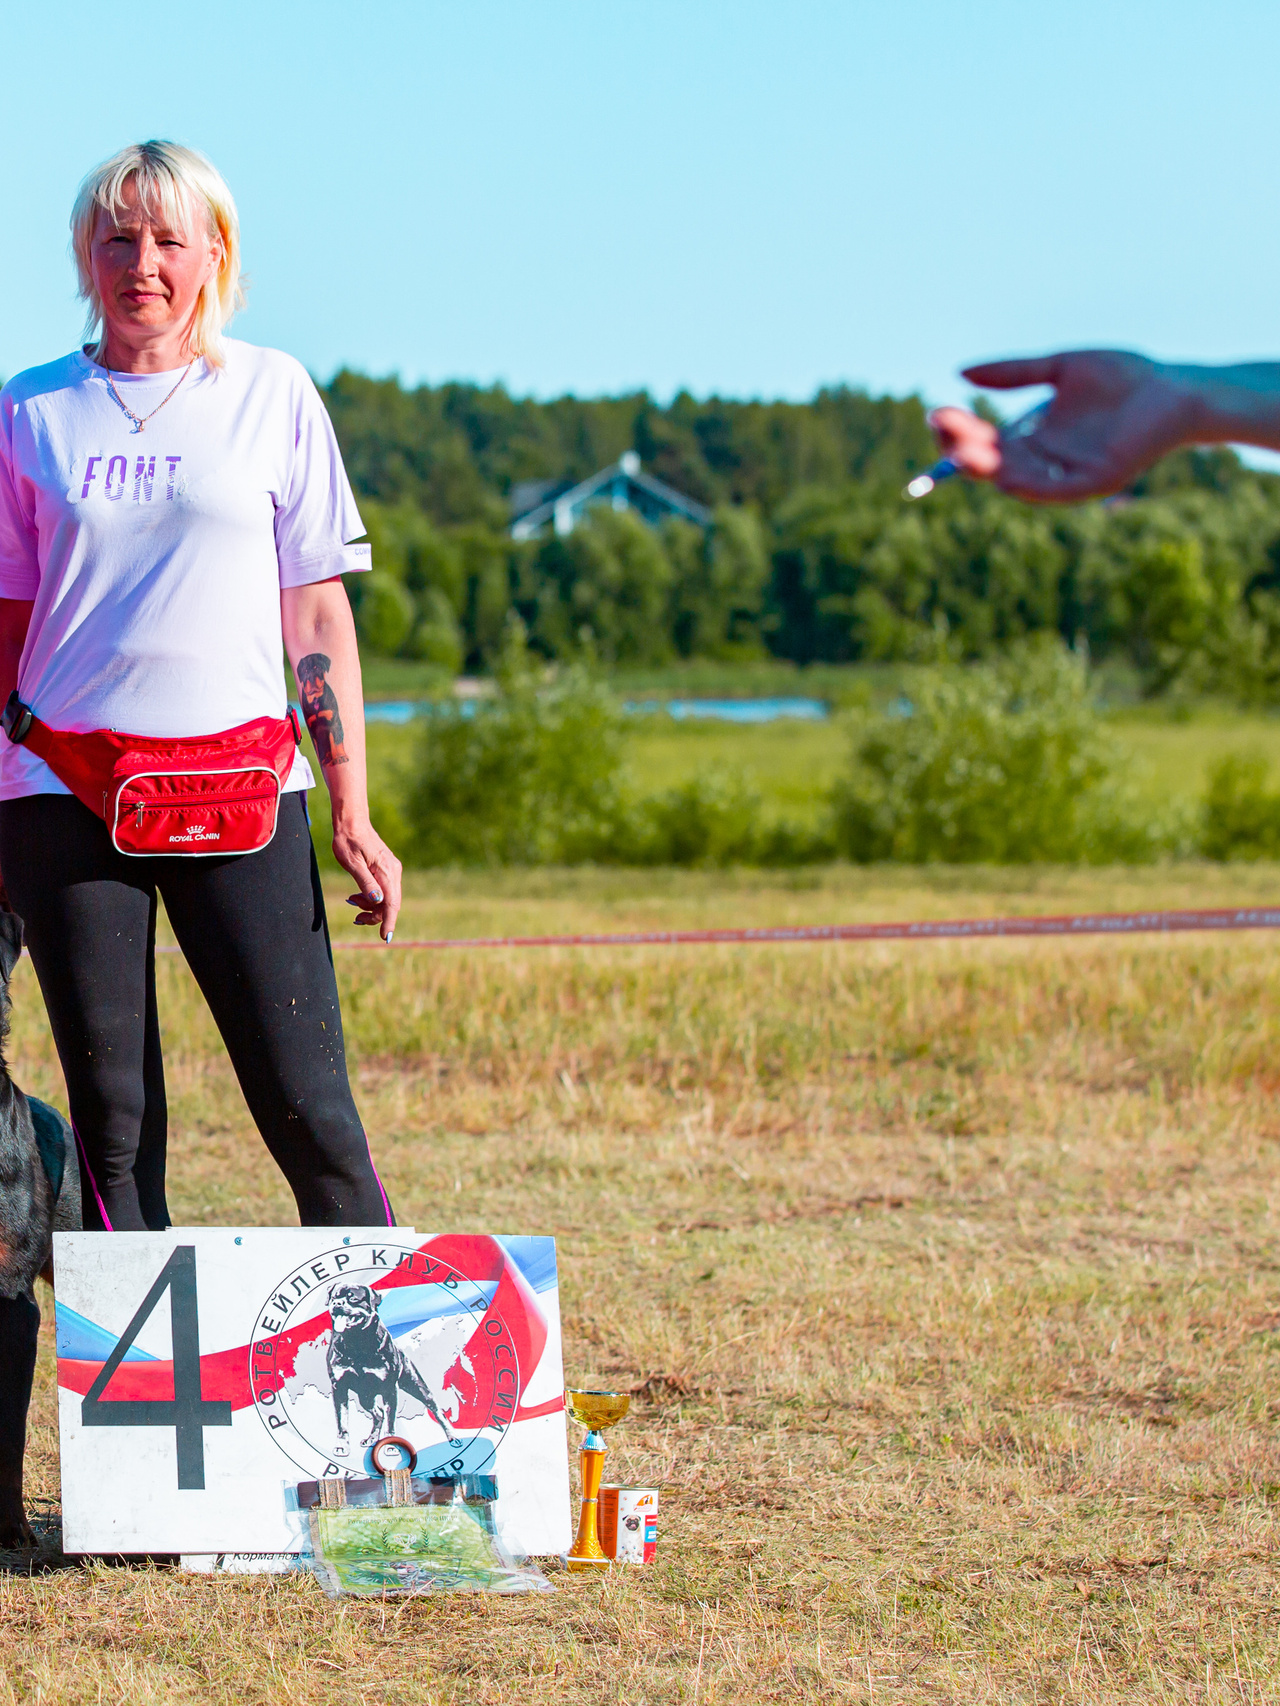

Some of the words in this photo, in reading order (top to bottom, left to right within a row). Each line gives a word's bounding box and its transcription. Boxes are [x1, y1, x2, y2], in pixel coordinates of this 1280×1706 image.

[81, 454, 182, 502] FONT
[168, 834, 194, 843] ROYAL
[194, 832, 220, 841] CANIN
[80, 1245, 233, 1490] 4
[255, 1253, 351, 1431] РОТВЕЙЛЕР
[372, 1249, 463, 1290] КЛУБ
[469, 1297, 516, 1434] РОССИИ
